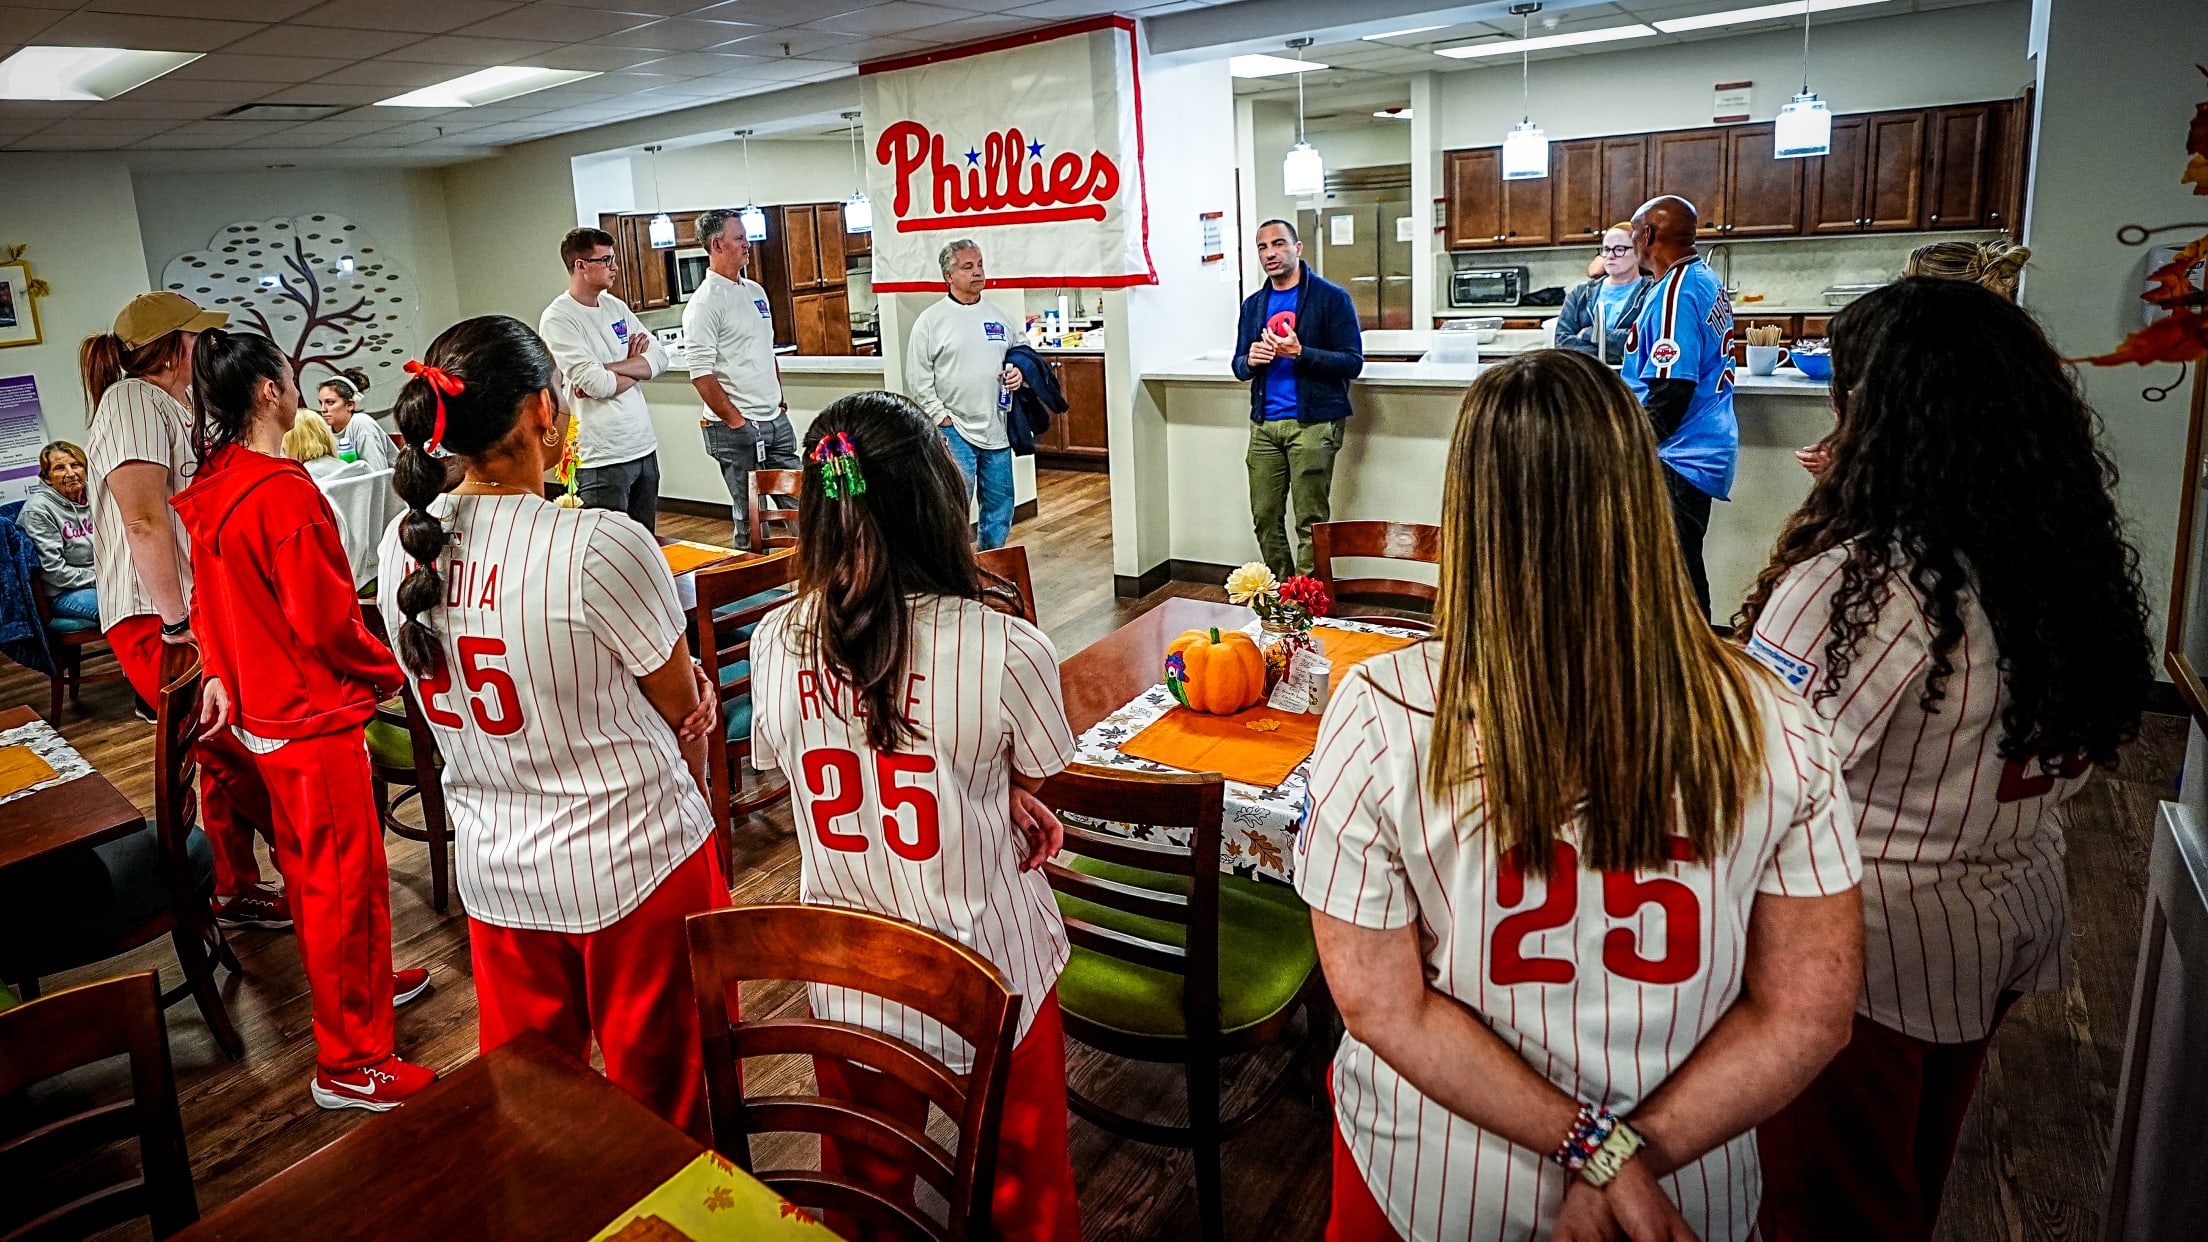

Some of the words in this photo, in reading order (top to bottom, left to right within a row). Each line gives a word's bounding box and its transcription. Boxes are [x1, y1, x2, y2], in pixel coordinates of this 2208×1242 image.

[876, 120, 1120, 218] Phillies
[417, 634, 525, 736] 25
[801, 748, 941, 862] 25
[1490, 836, 1701, 985] 25
